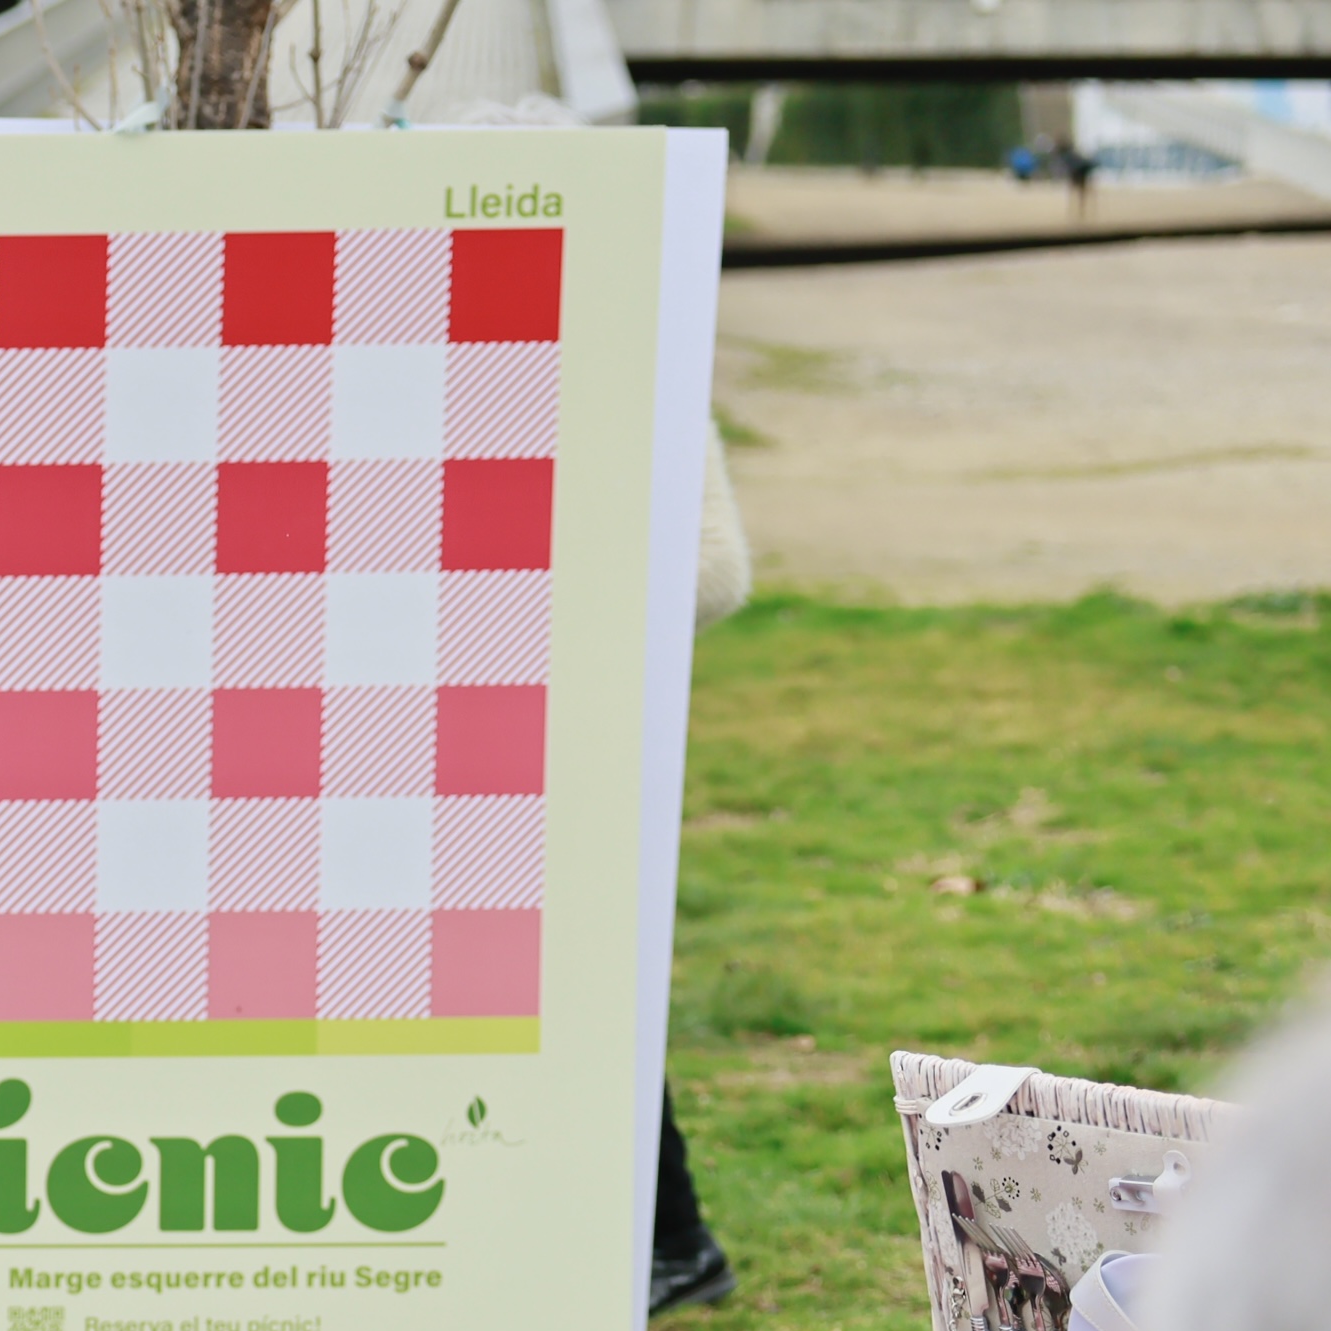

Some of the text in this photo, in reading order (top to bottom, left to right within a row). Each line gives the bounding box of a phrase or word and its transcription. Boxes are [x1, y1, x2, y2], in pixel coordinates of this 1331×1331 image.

[444, 183, 564, 220] Lleida
[9, 1265, 443, 1295] Marge esquerre del riu Segre
